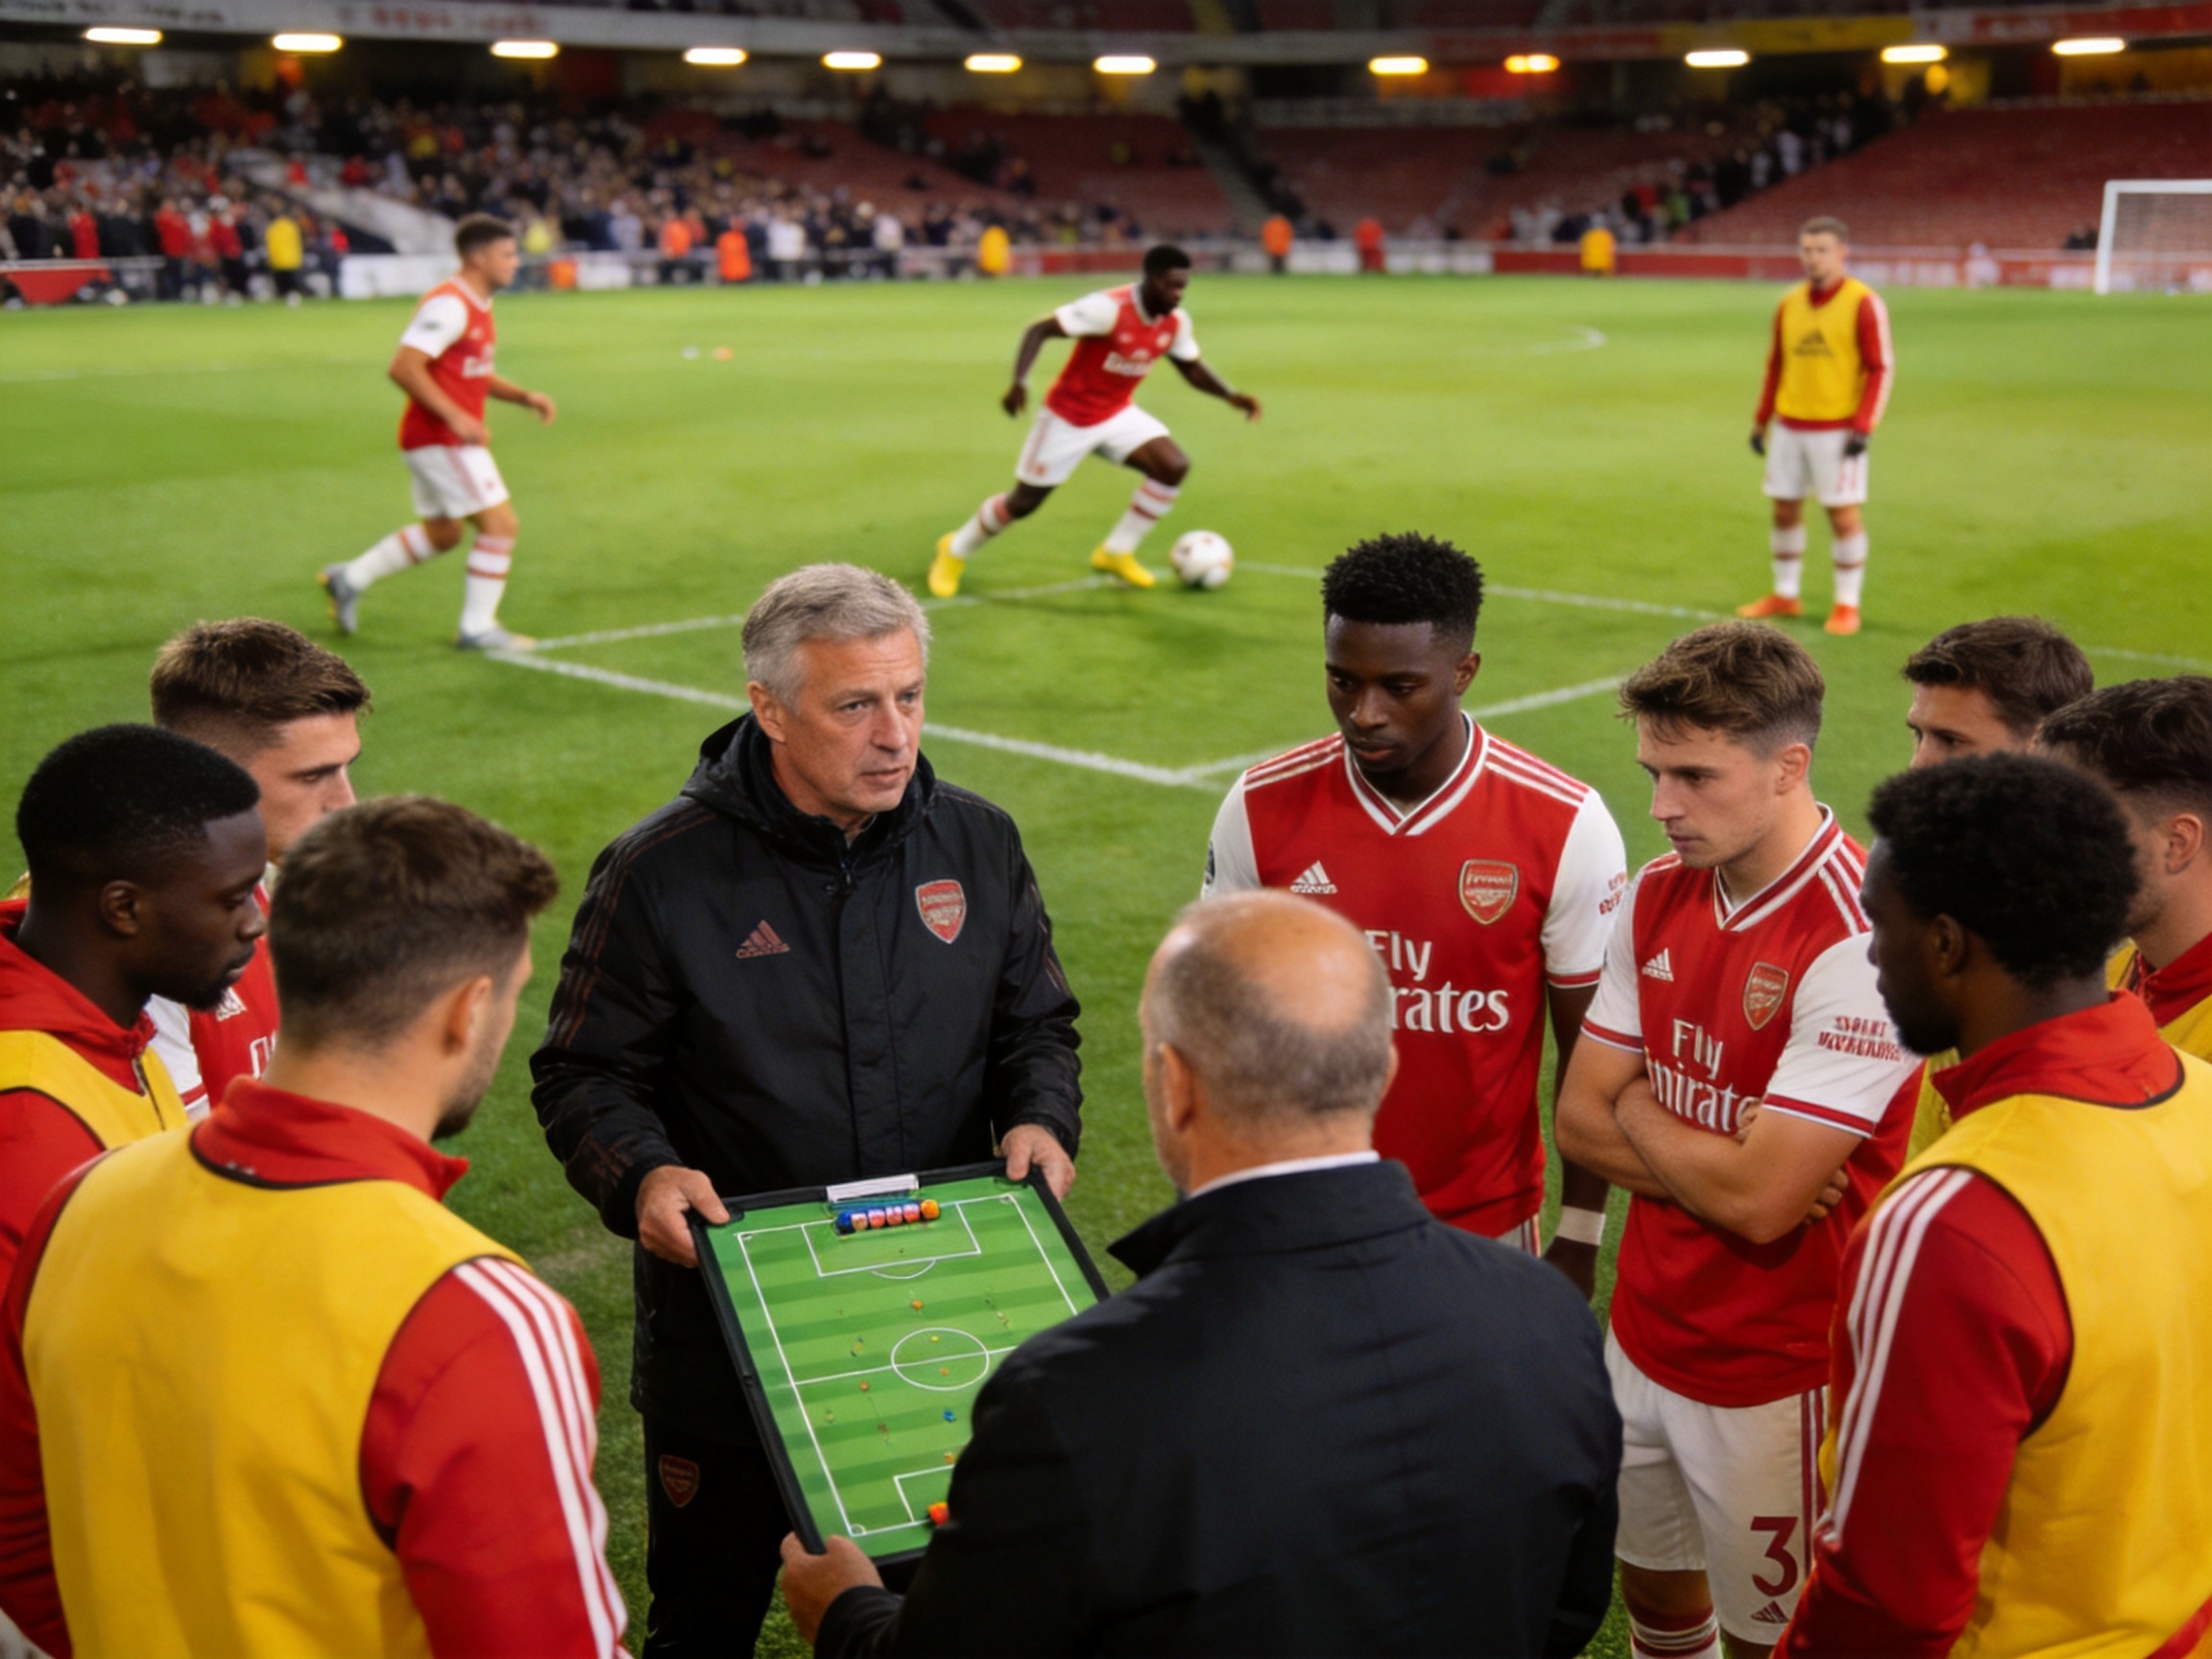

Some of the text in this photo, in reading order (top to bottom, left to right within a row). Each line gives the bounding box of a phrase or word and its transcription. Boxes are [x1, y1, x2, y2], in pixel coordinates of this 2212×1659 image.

[1364, 929, 1432, 981] Fly
[1387, 980, 1509, 1034] rates
[1672, 1018, 1723, 1080] Fly
[1750, 1516, 1798, 1598] 3
